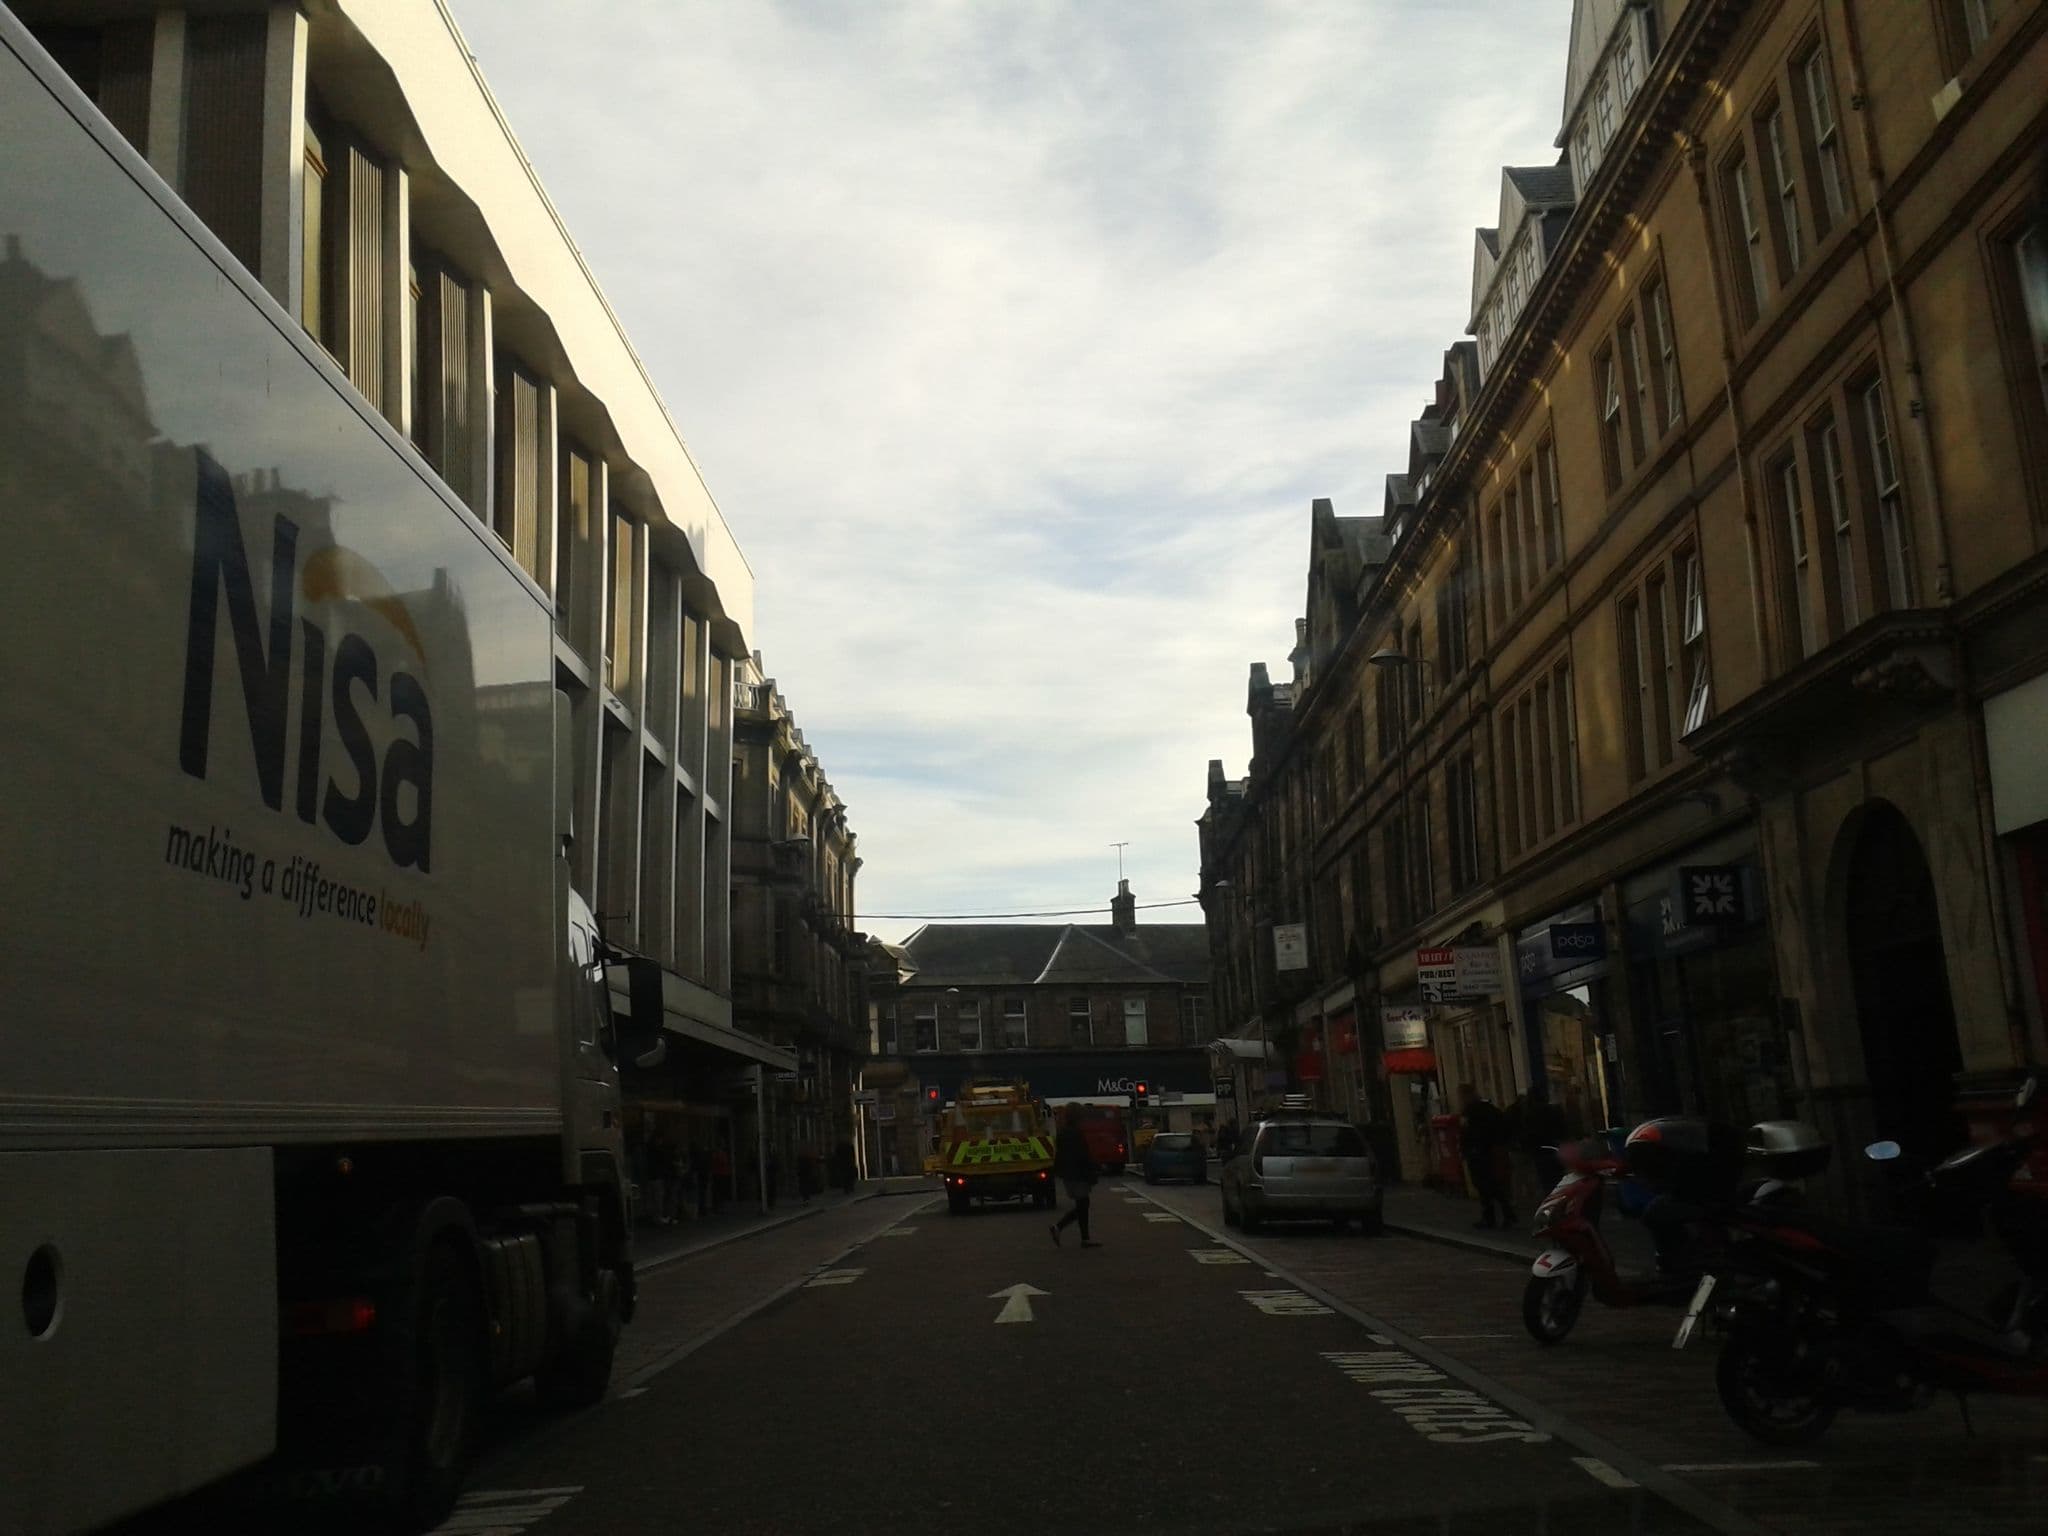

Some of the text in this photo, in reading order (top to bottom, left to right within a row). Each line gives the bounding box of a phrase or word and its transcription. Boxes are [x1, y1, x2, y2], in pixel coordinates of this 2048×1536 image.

[180, 443, 434, 875] Nisa
[166, 823, 431, 953] making a difference locally
[1557, 931, 1596, 948] pdsa
[1097, 1077, 1135, 1093] M&Co
